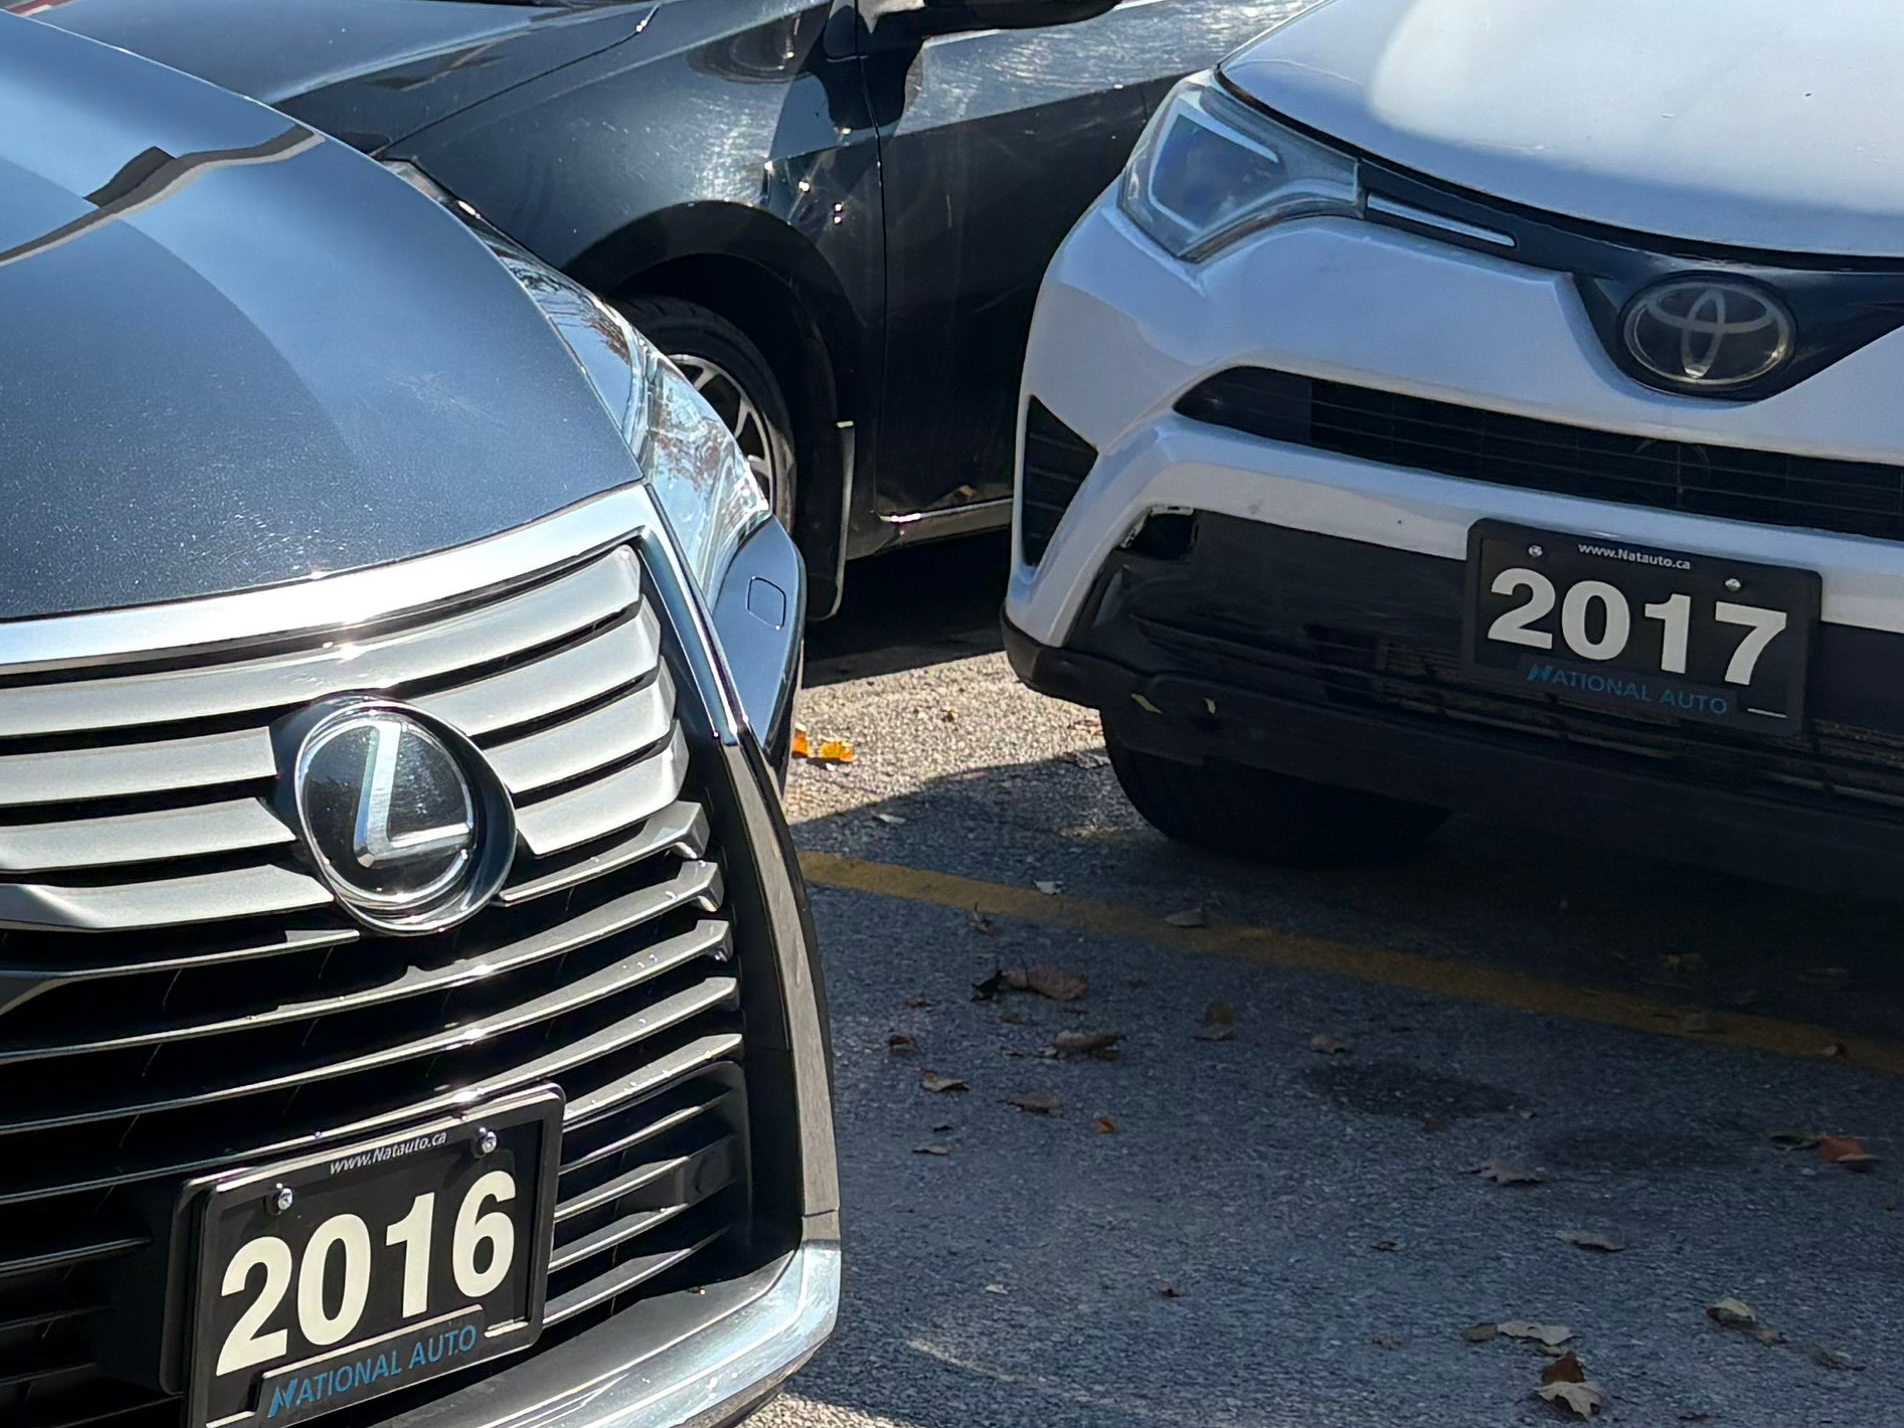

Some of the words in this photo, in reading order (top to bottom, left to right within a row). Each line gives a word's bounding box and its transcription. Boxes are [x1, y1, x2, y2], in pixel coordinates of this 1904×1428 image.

[1578, 543, 1691, 570] www.Natauto.ca
[1488, 568, 1788, 685] 2017
[1526, 663, 1652, 702] NATIONAL
[1659, 691, 1728, 715] AUTO
[329, 1131, 448, 1176] www.Natauto.ca
[216, 1170, 517, 1377] 2016
[267, 1350, 402, 1419] NATIONAL
[408, 1324, 479, 1370] AUTO
